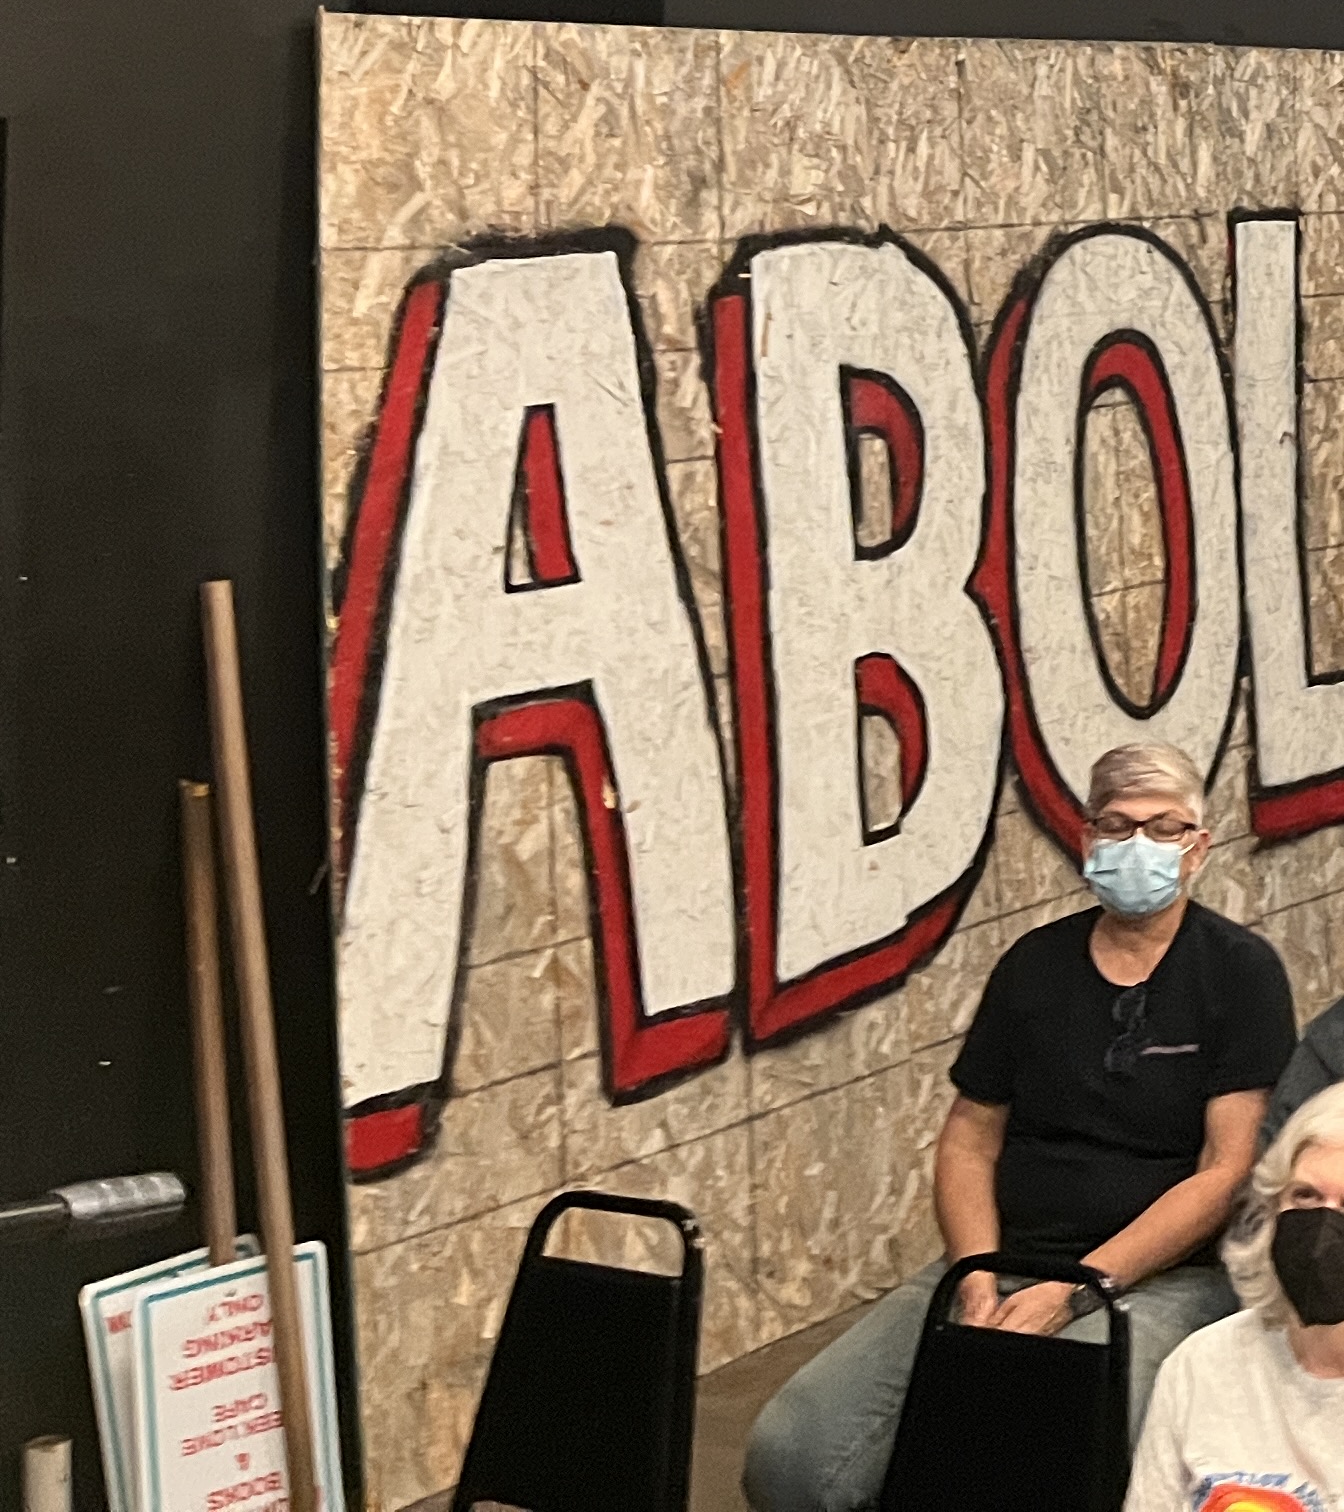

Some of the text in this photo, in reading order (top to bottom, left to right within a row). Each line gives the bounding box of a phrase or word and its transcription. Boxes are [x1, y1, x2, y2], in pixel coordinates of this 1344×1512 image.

[207, 1295, 264, 1323] ONLY
[182, 1320, 272, 1359] ARKING
[169, 1348, 273, 1392] STOMER
